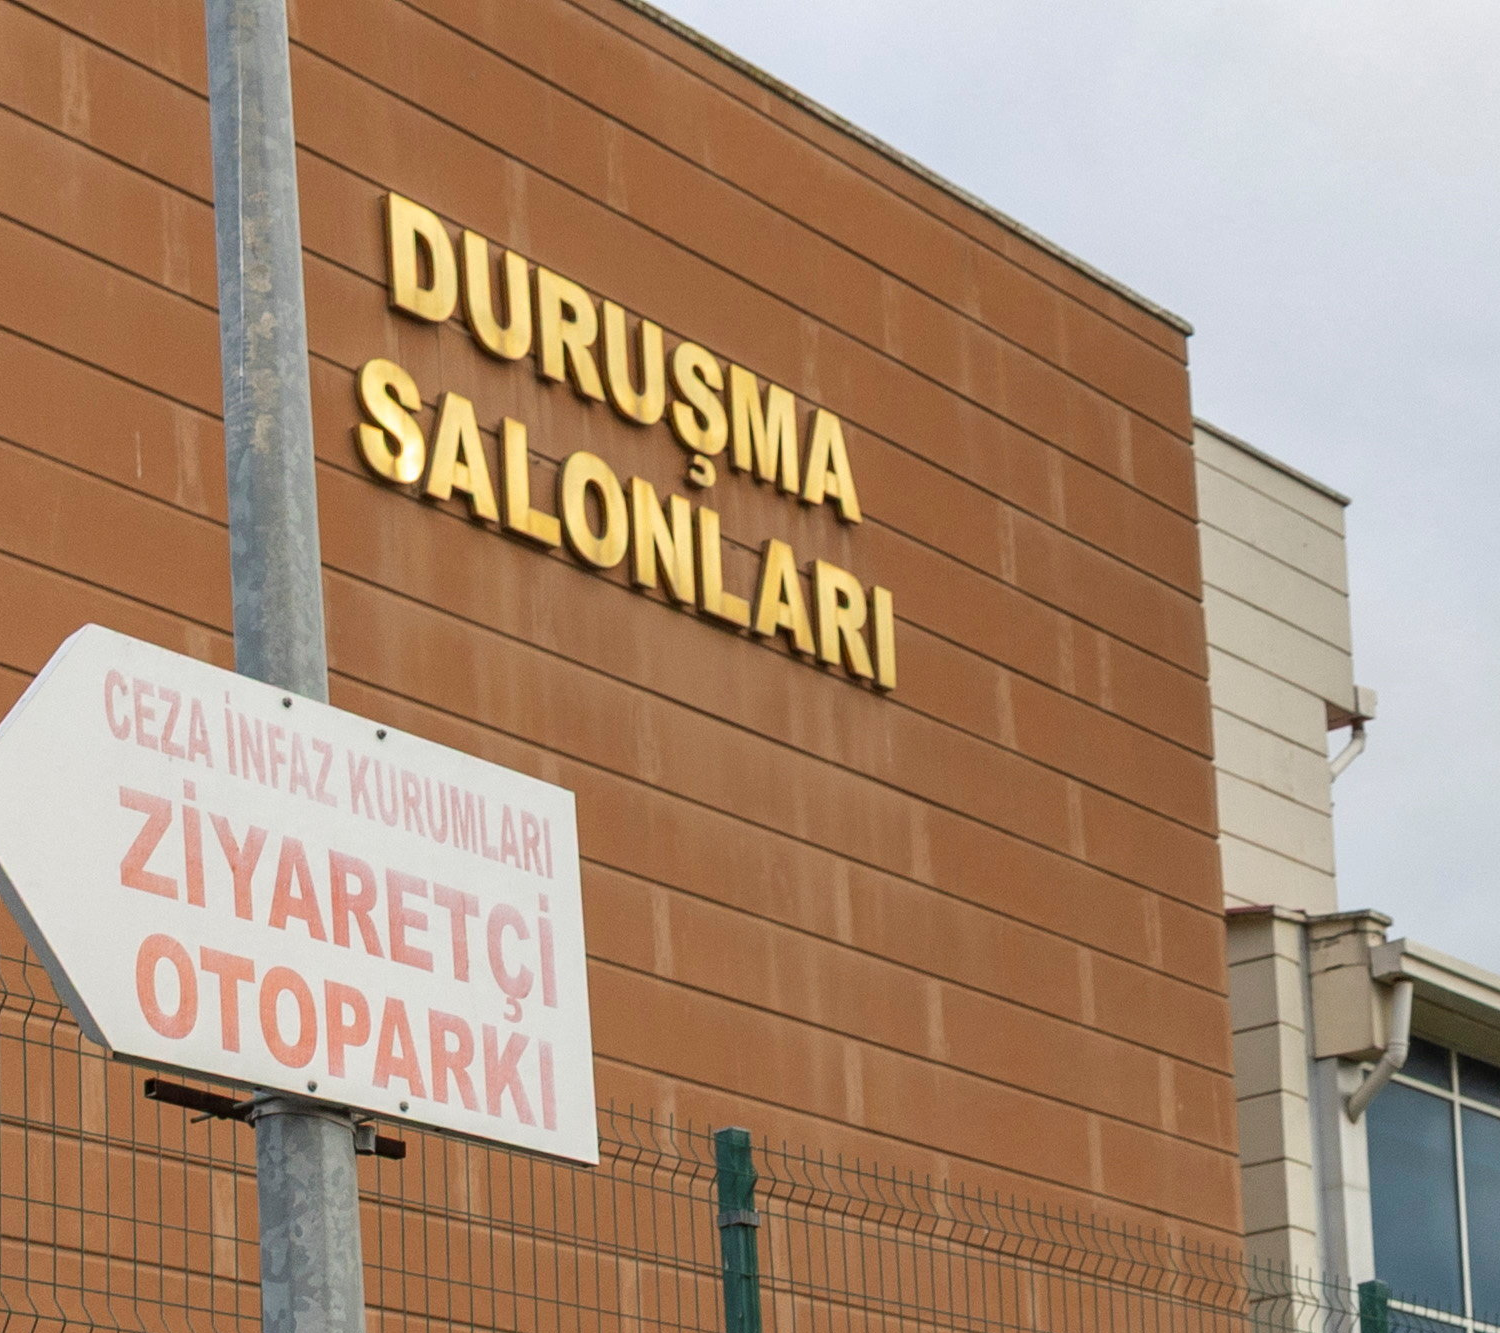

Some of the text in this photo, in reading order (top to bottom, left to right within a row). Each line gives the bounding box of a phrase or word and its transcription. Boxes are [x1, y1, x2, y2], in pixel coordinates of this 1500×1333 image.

[384, 191, 862, 525] DURUŞMA
[353, 357, 897, 692] SALONLARI
[103, 668, 555, 880] CEZA İNFAZ KURUMLARI
[118, 778, 559, 1023] ZİYARETÇİ
[135, 932, 558, 1132] OTOPARKI
